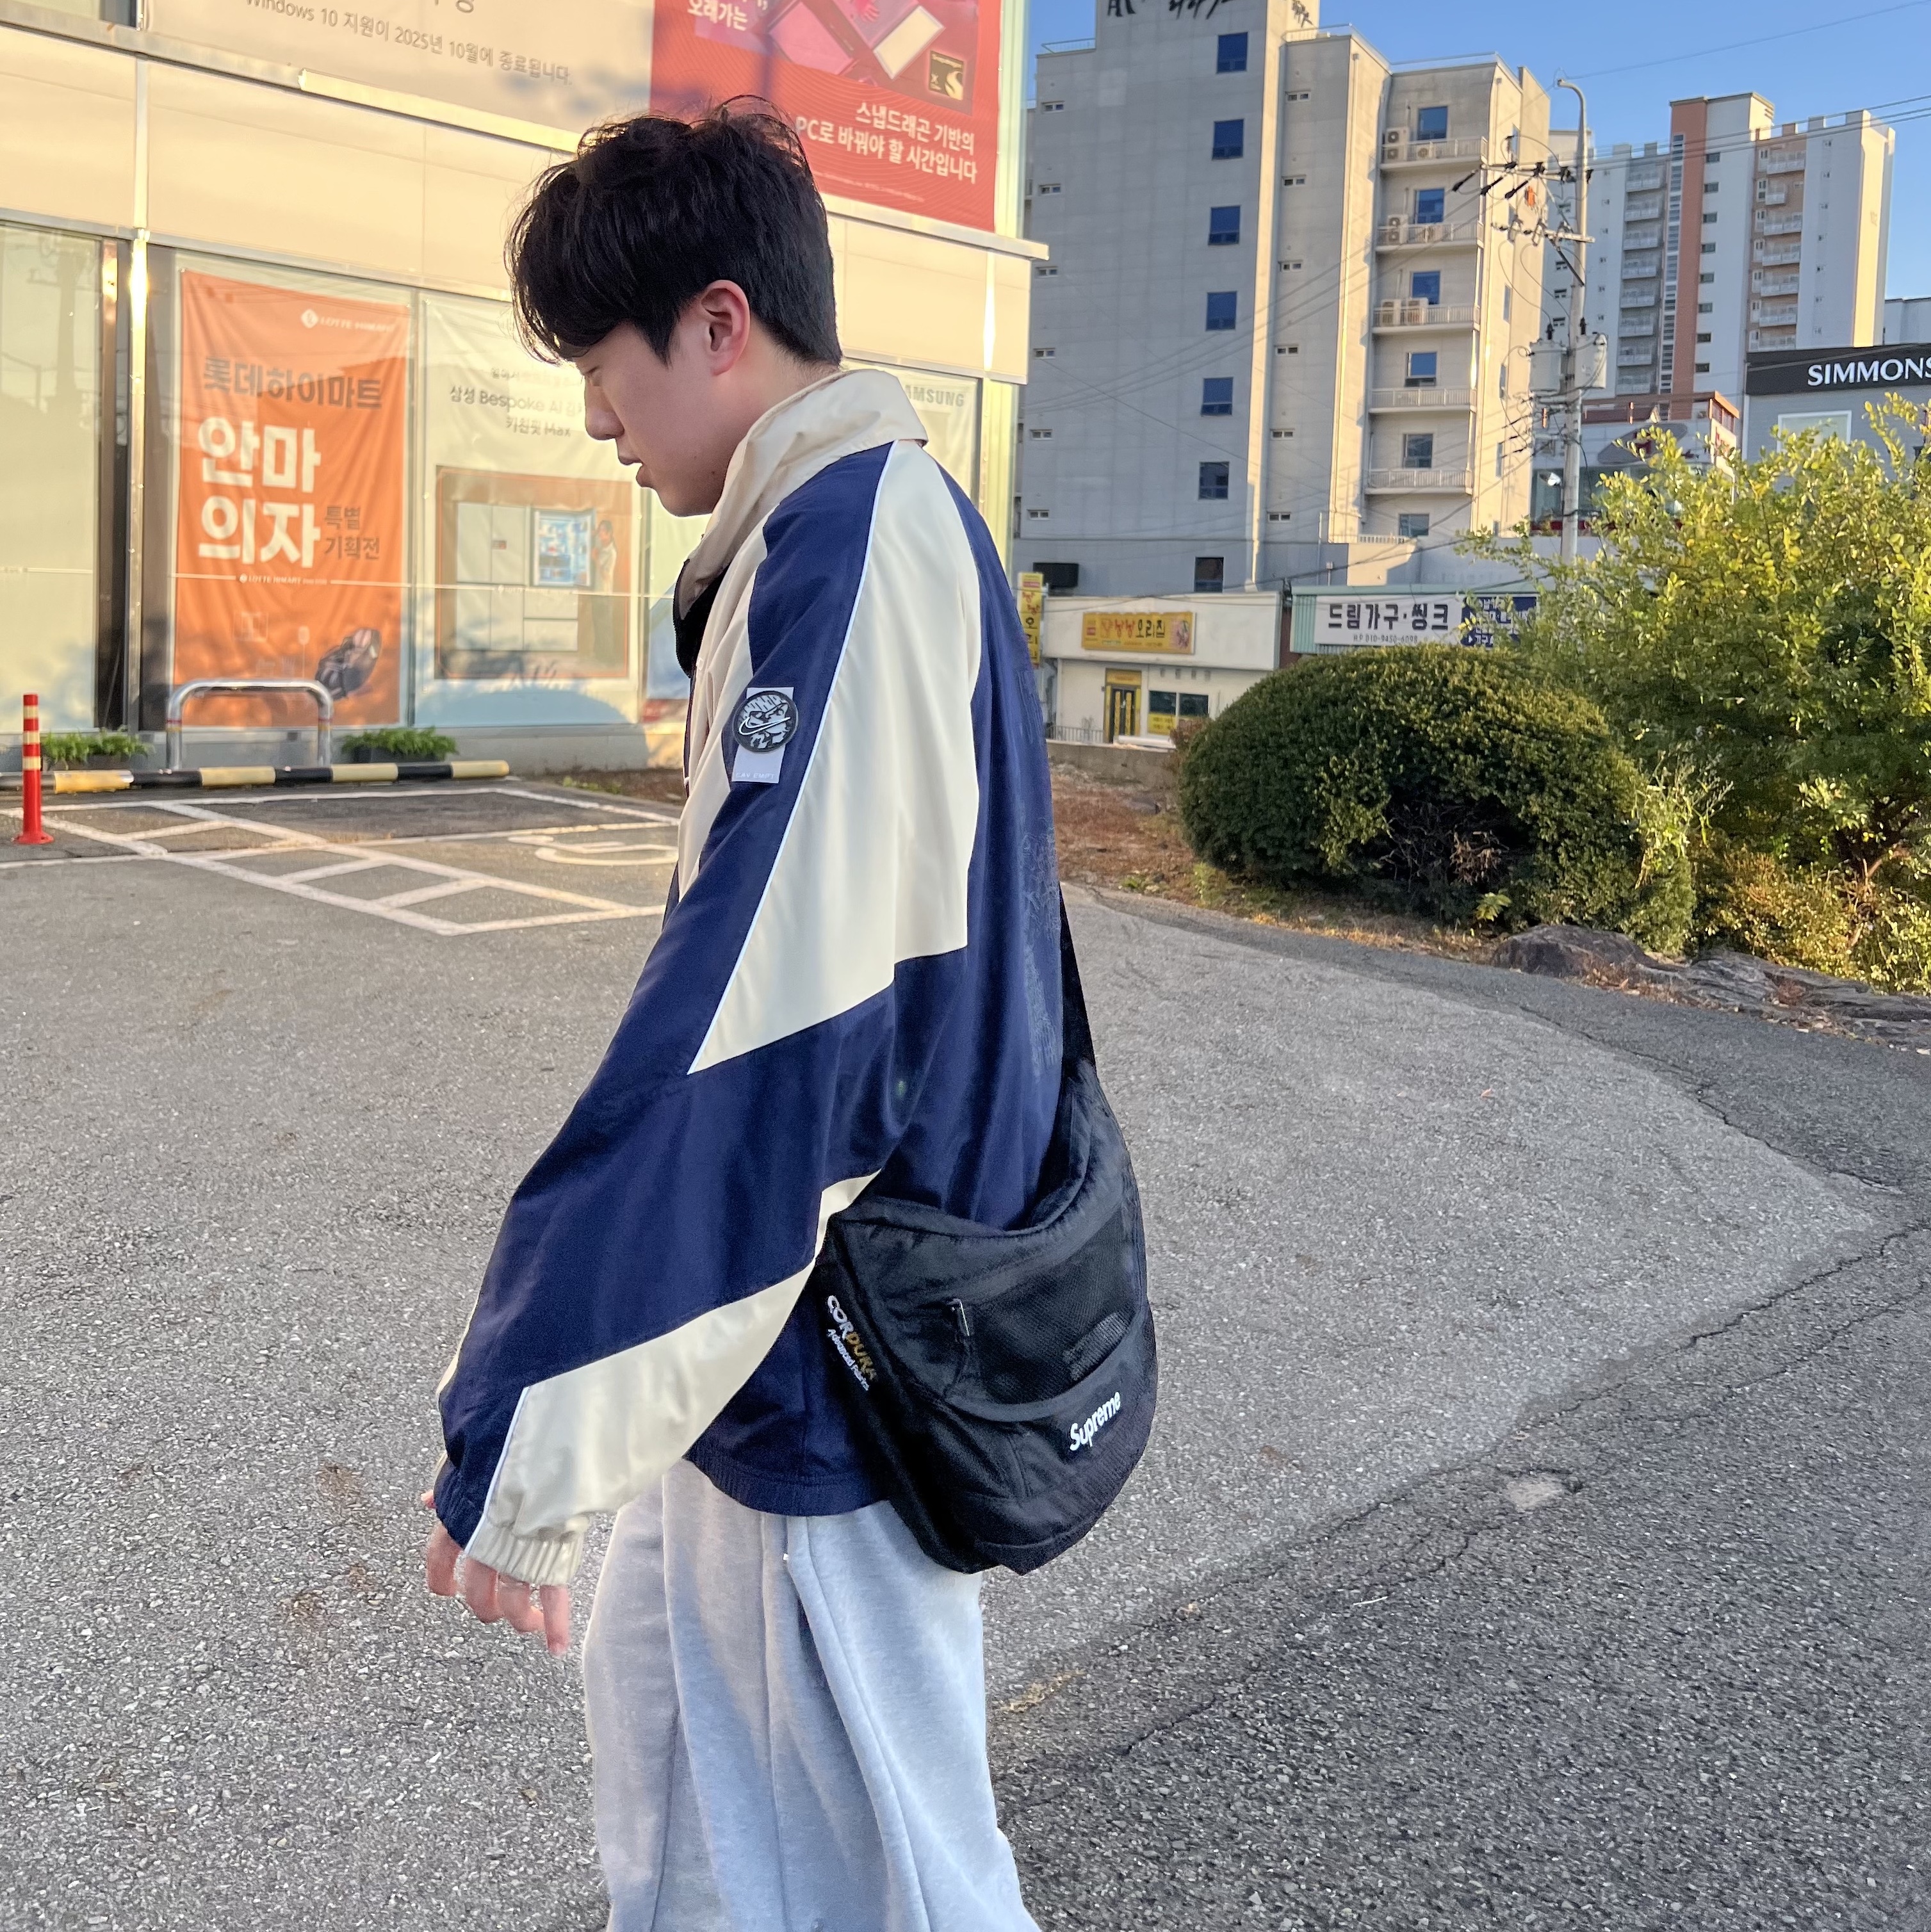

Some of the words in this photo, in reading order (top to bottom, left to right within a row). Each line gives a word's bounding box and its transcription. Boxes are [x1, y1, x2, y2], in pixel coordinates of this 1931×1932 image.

[320, 8, 338, 28] 10
[344, 12, 389, 42] 지원이
[395, 26, 443, 55] 2025년
[449, 40, 494, 67] 10월에
[687, 0, 748, 31] 오래가는
[795, 115, 835, 145] PC로
[837, 126, 885, 159] 바꿔야
[887, 139, 904, 165] 할
[906, 146, 978, 185] 시간입니다
[855, 101, 932, 143] 스냅드래곤
[934, 124, 975, 156] 기반의
[204, 355, 382, 410] 롯데하이마트
[450, 385, 475, 405] 삼성
[479, 391, 545, 412] Bespoke
[904, 384, 965, 408] AMSUNG
[197, 416, 322, 493] 안마
[544, 419, 571, 437] Max
[197, 495, 321, 569] 의자
[325, 505, 361, 531] 특별
[324, 536, 380, 561] 기획전
[1070, 1392, 1121, 1451] Supreme
